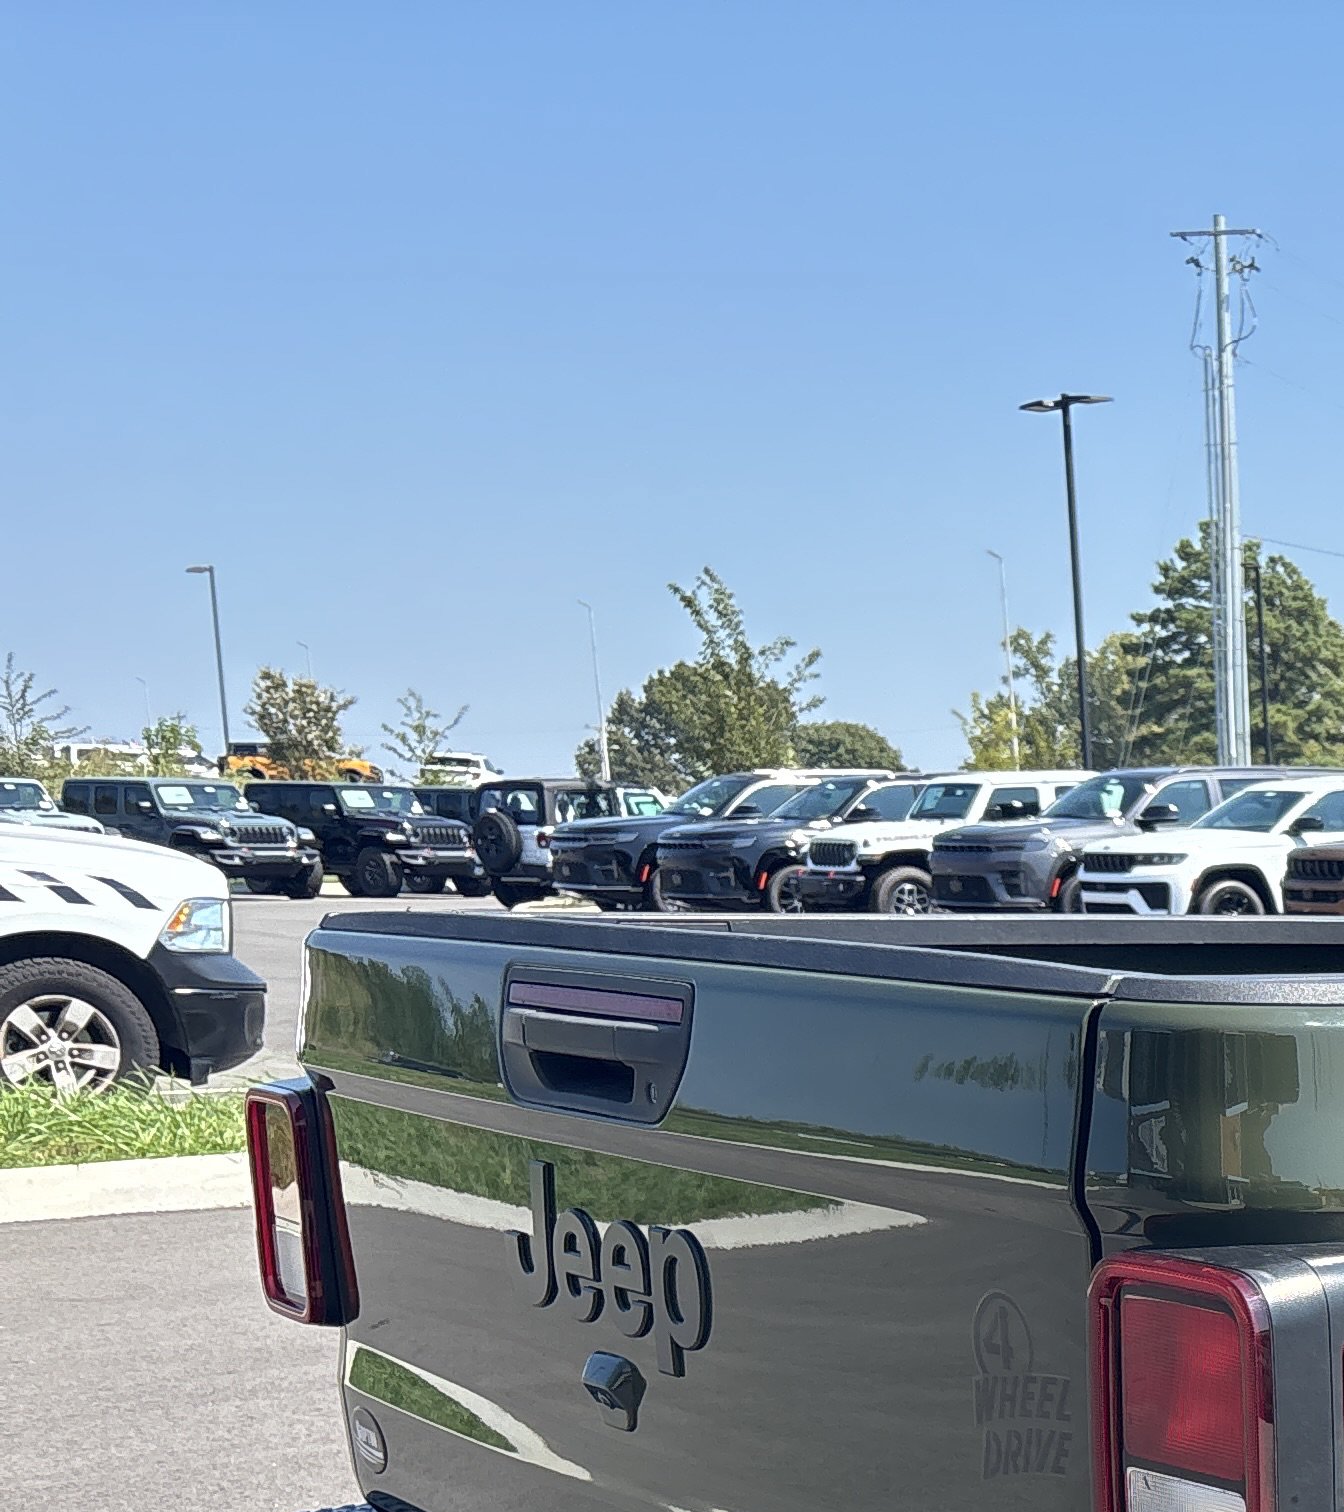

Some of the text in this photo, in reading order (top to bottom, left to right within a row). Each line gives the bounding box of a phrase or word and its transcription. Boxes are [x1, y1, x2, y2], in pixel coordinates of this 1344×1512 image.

[503, 1159, 713, 1378] Jeep
[974, 1374, 1072, 1425] WHEEL
[983, 1427, 1073, 1480] DRIVE
